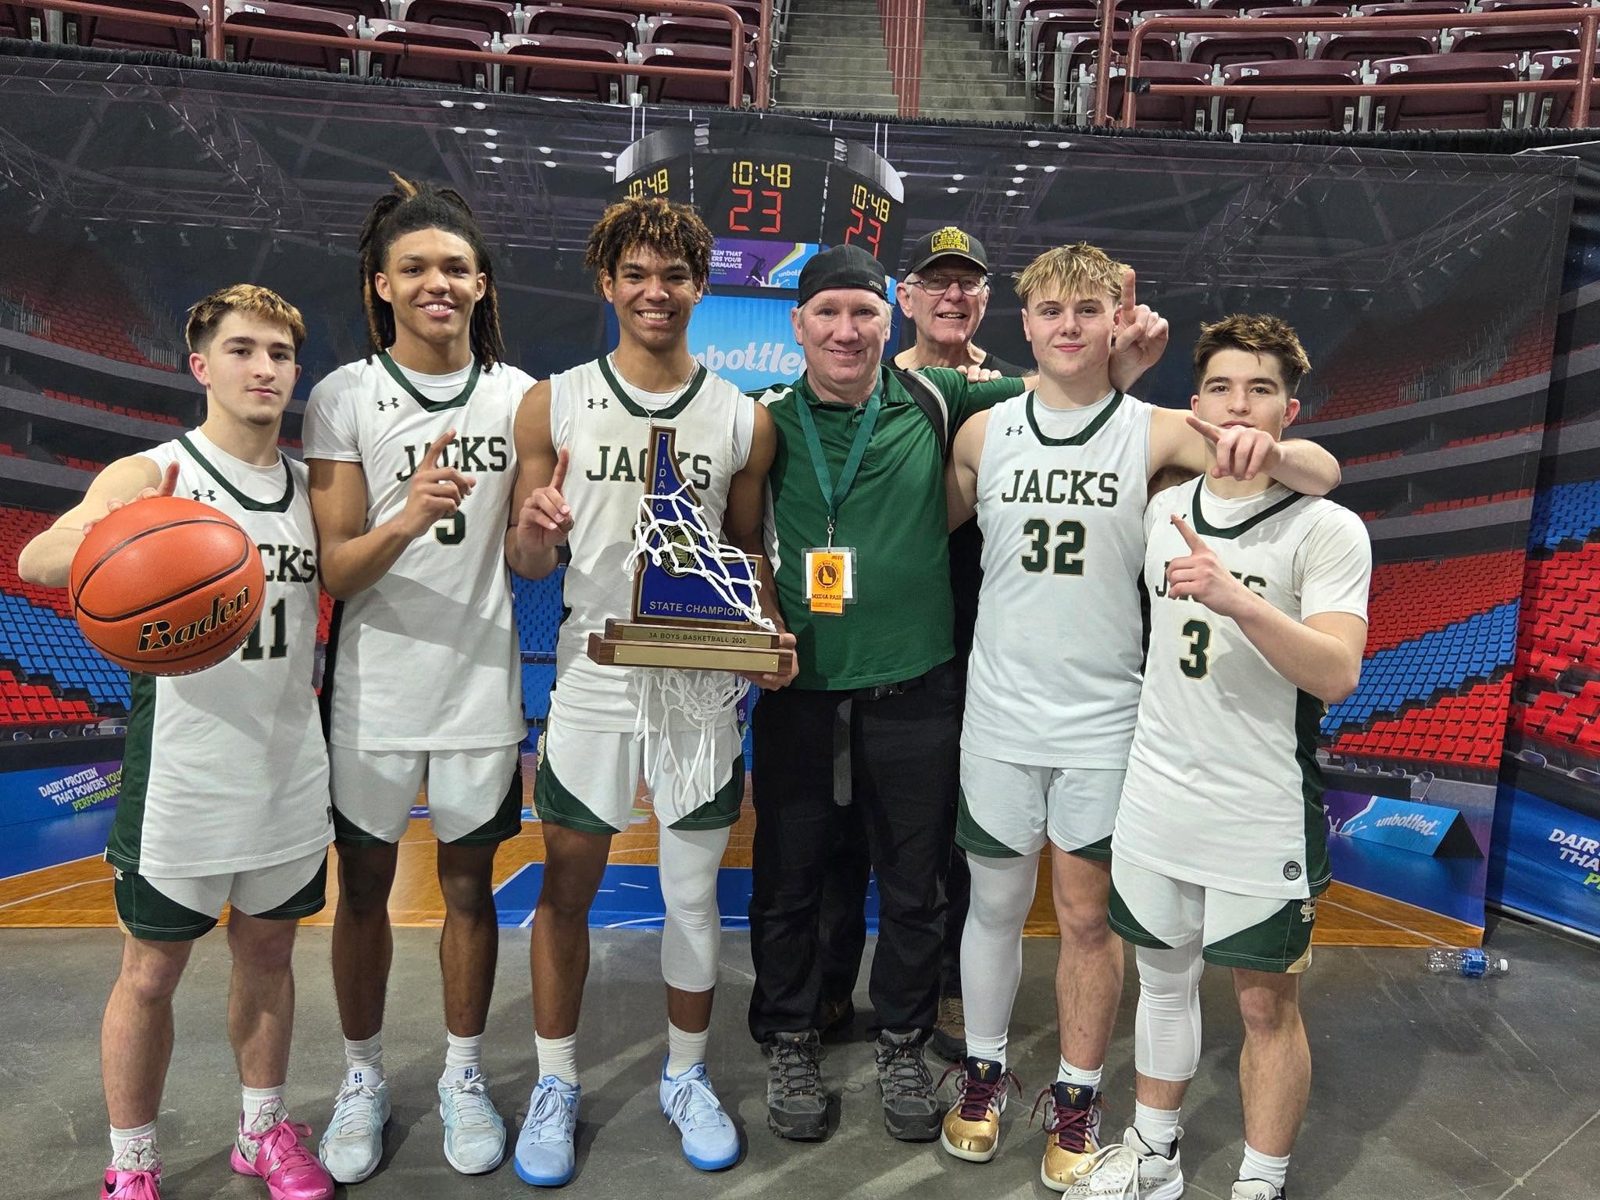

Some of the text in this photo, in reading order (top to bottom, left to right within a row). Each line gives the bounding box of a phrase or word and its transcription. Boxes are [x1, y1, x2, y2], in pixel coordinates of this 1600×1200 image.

[731, 160, 791, 189] 10:48
[729, 188, 783, 234] 23
[852, 183, 891, 223] 10:48
[396, 436, 507, 481] JCKS
[655, 456, 667, 513] IDAO
[1001, 469, 1119, 508] JACKS
[257, 543, 316, 584] CKS
[1020, 518, 1087, 577] 32
[137, 586, 250, 652] Baden
[649, 600, 684, 612] STATE
[660, 632, 680, 640] BOYS
[682, 635, 730, 643] BASKETBALL
[1179, 619, 1213, 681] 3
[38, 767, 99, 798] DAIRY PROTEIN
[51, 788, 76, 806] THAT
[74, 777, 107, 798] POWERS
[71, 782, 122, 812] PERFORMANC
[1548, 828, 1600, 857] DAIR
[1559, 847, 1600, 872] THA
